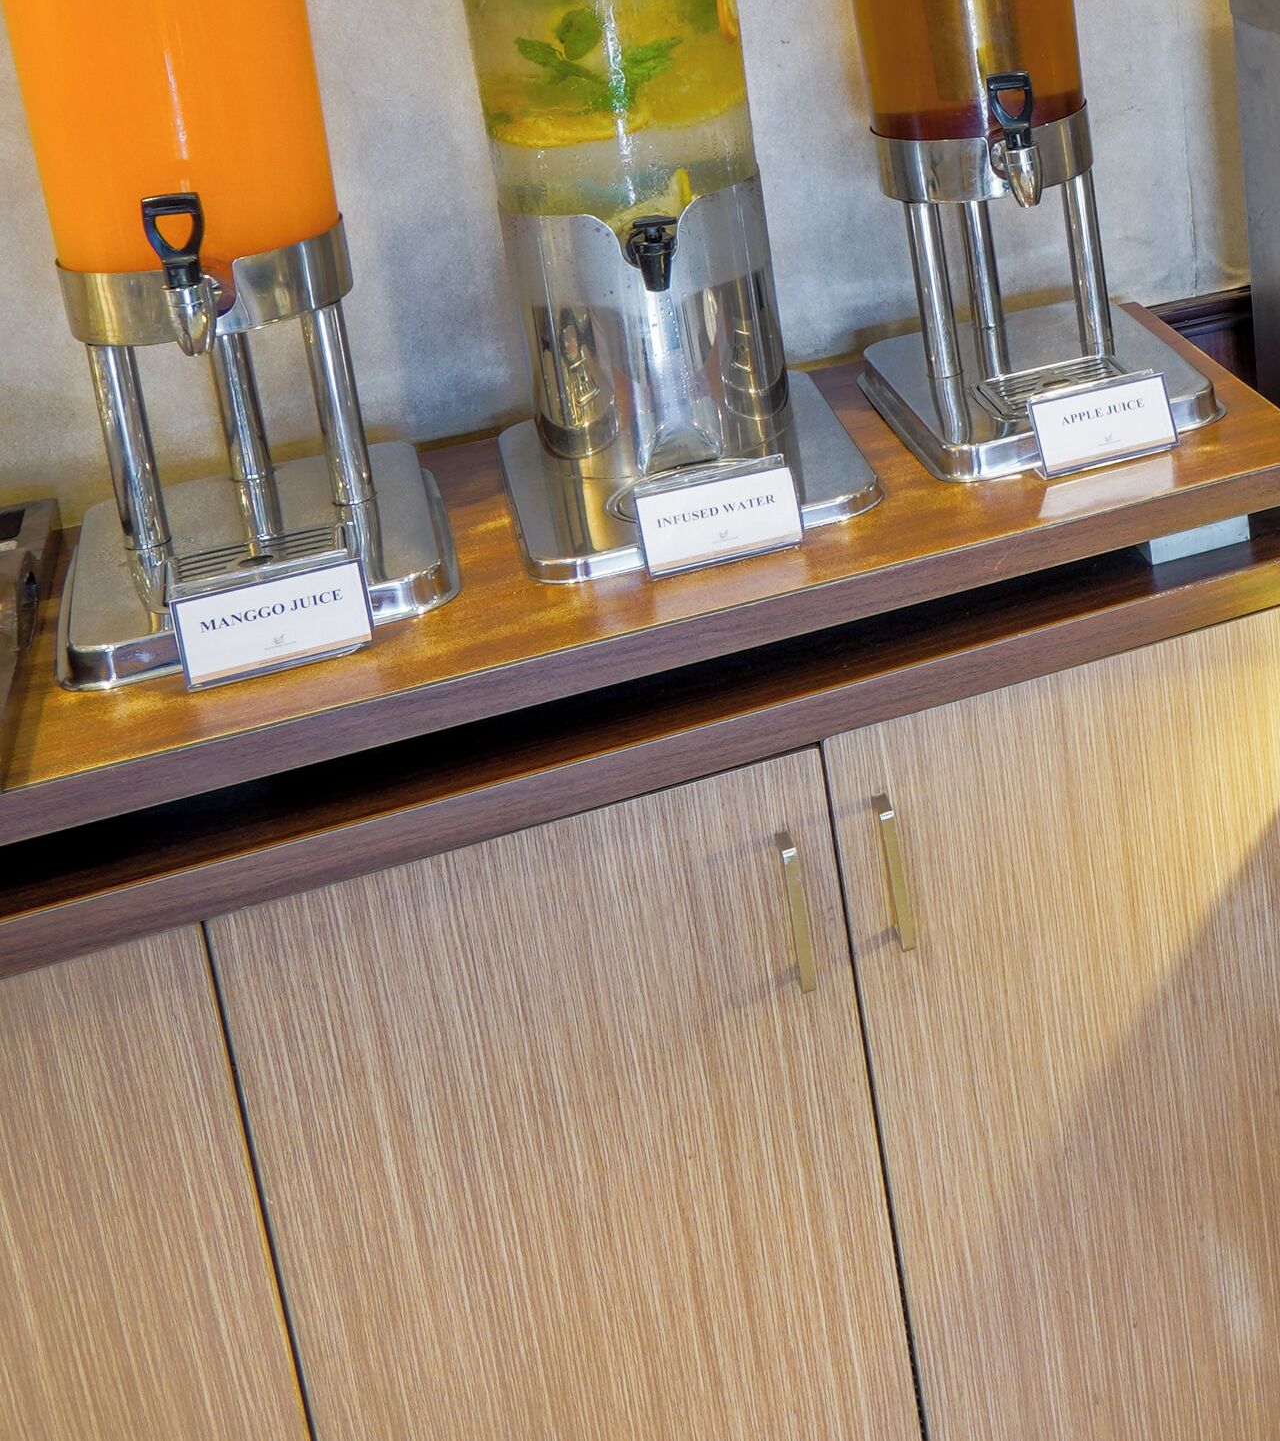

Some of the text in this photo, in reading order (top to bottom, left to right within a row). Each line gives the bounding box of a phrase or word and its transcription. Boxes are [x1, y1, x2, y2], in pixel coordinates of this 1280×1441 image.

[1062, 399, 1145, 426] APPLE JUICE
[657, 494, 776, 528] INFUSED WATER
[200, 589, 344, 633] MANGGO JUICE
